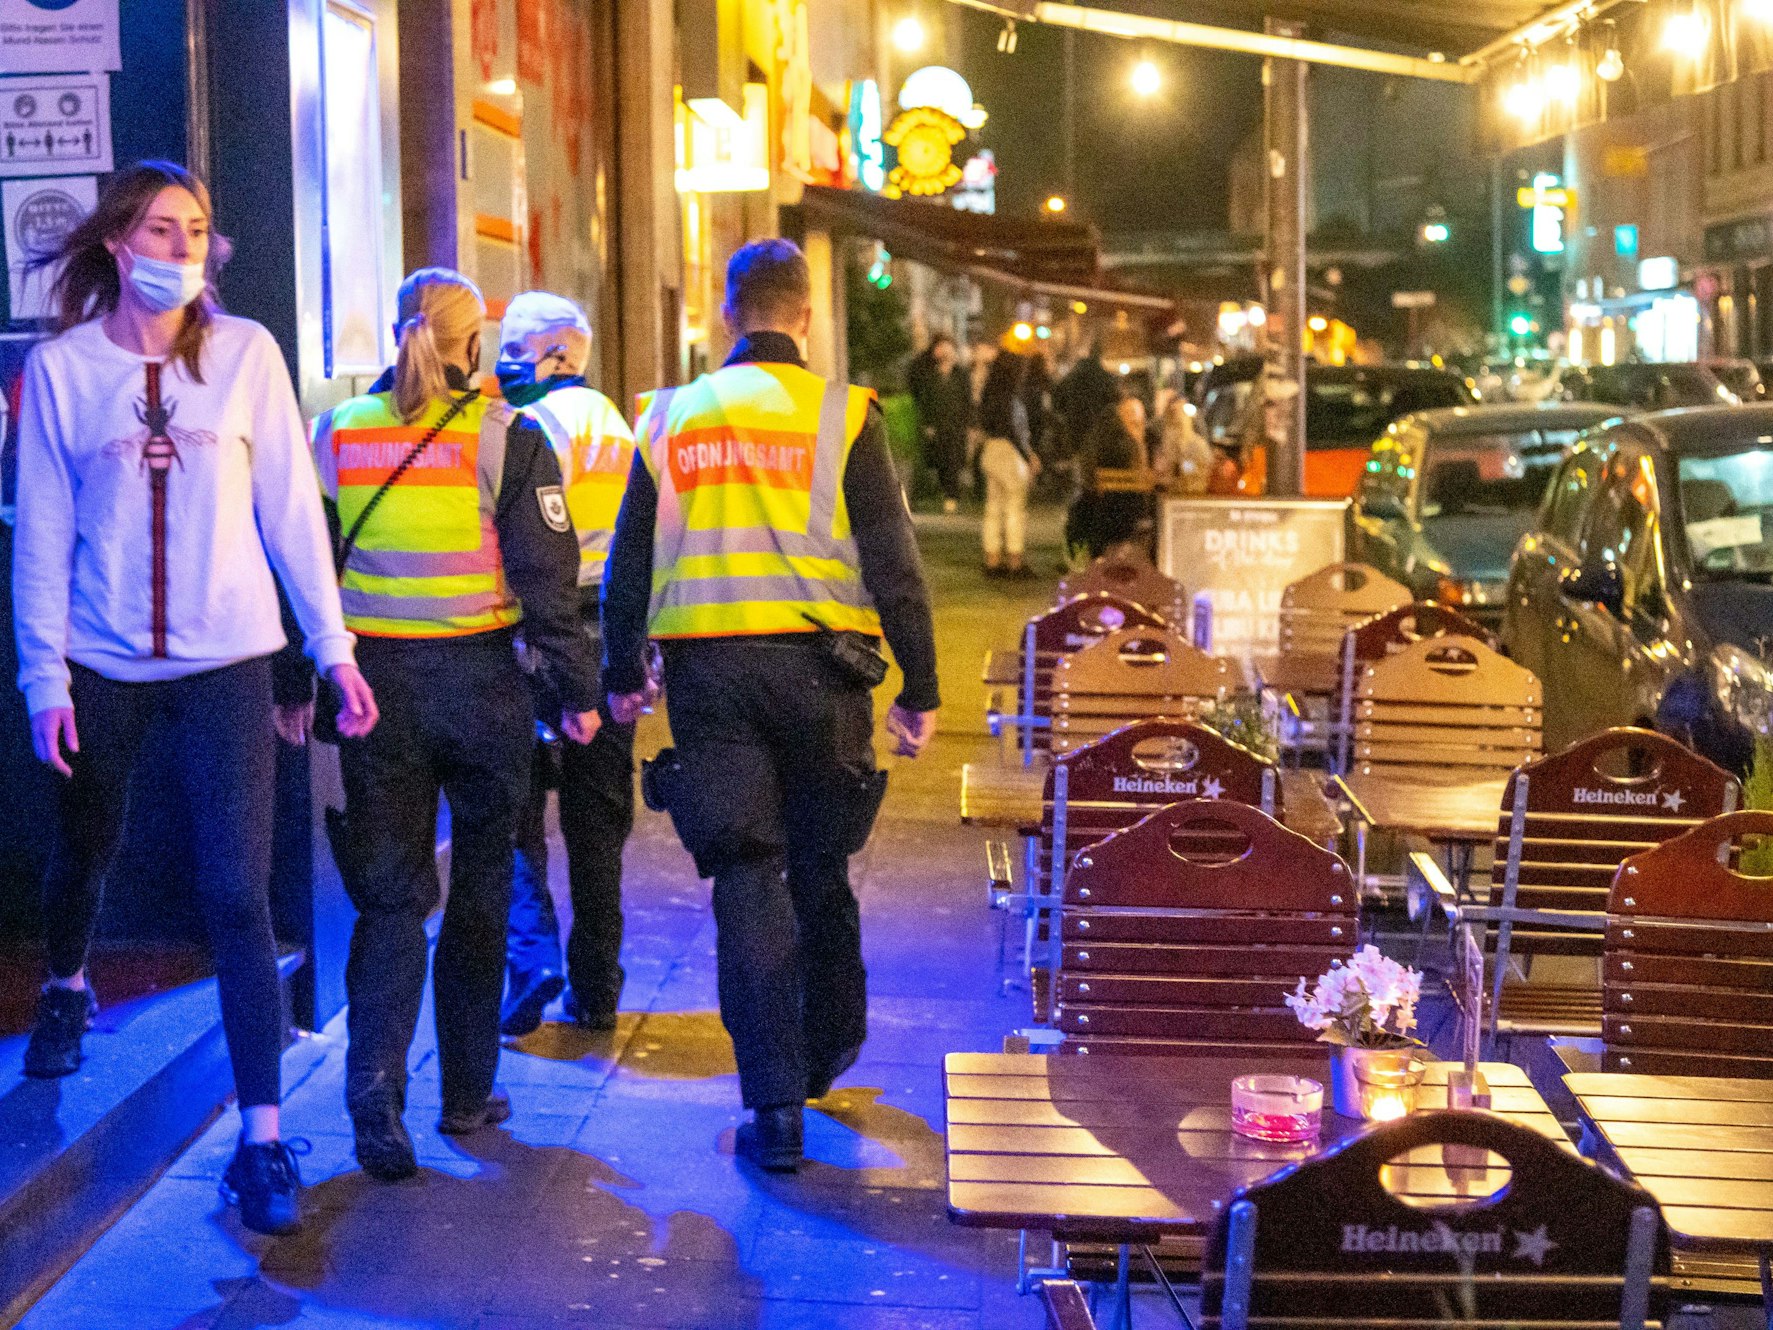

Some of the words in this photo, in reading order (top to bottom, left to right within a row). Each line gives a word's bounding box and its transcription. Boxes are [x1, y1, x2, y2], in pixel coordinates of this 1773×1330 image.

[1205, 528, 1299, 553] DRINKS
[1113, 776, 1197, 794] Heineken
[1573, 787, 1657, 805] Heineken
[1341, 1222, 1502, 1253] Heineken
